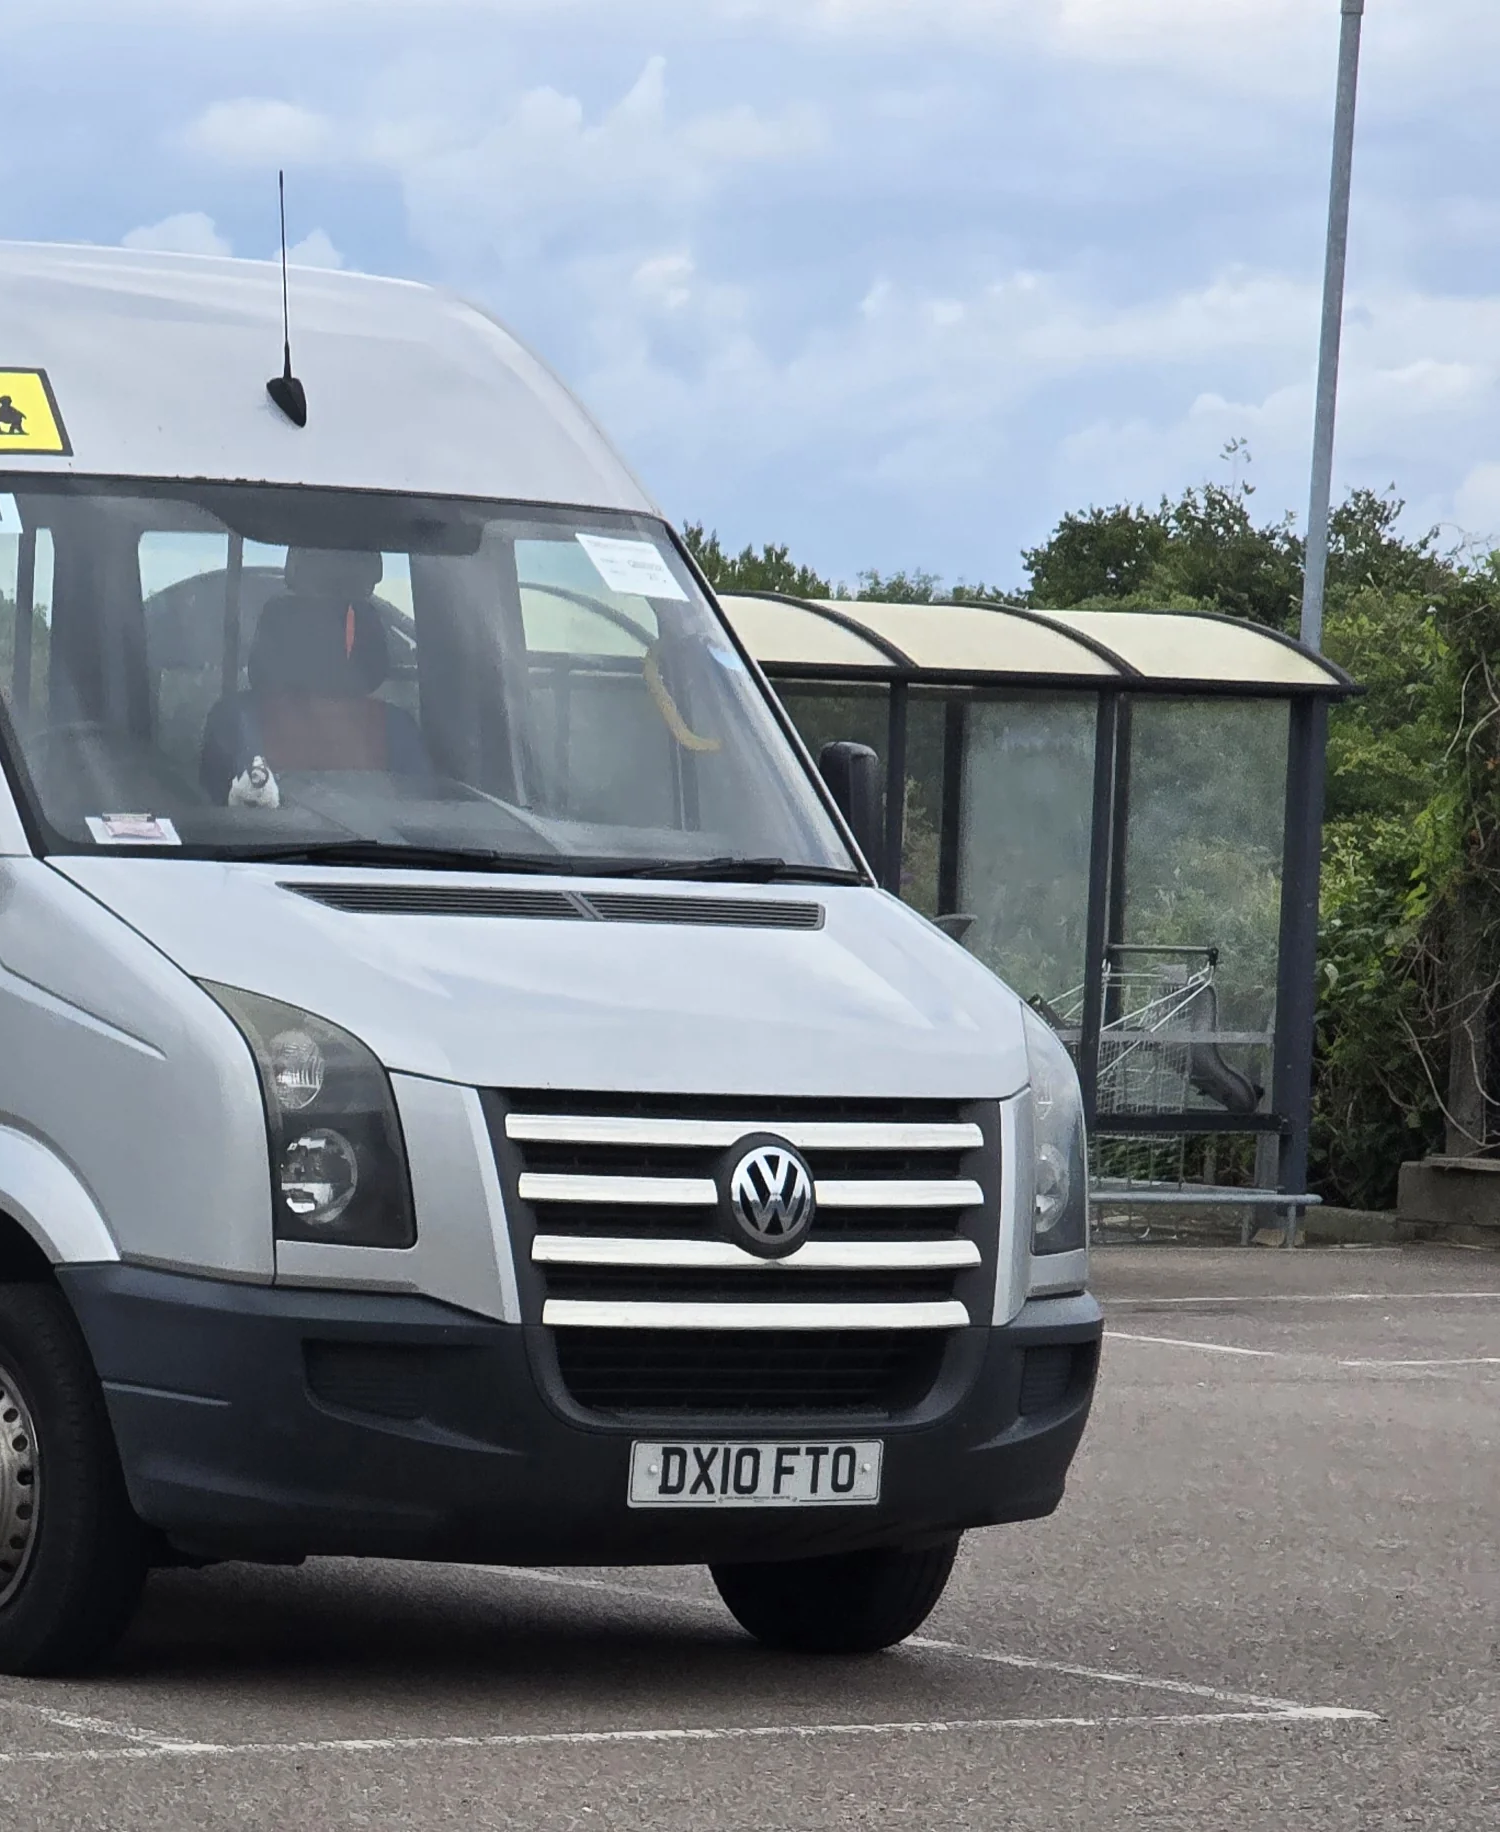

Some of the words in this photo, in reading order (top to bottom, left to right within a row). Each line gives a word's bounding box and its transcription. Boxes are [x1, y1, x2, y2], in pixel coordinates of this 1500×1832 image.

[733, 1147, 810, 1243] VW
[658, 1446, 761, 1494] DX10
[773, 1446, 856, 1494] FTO
